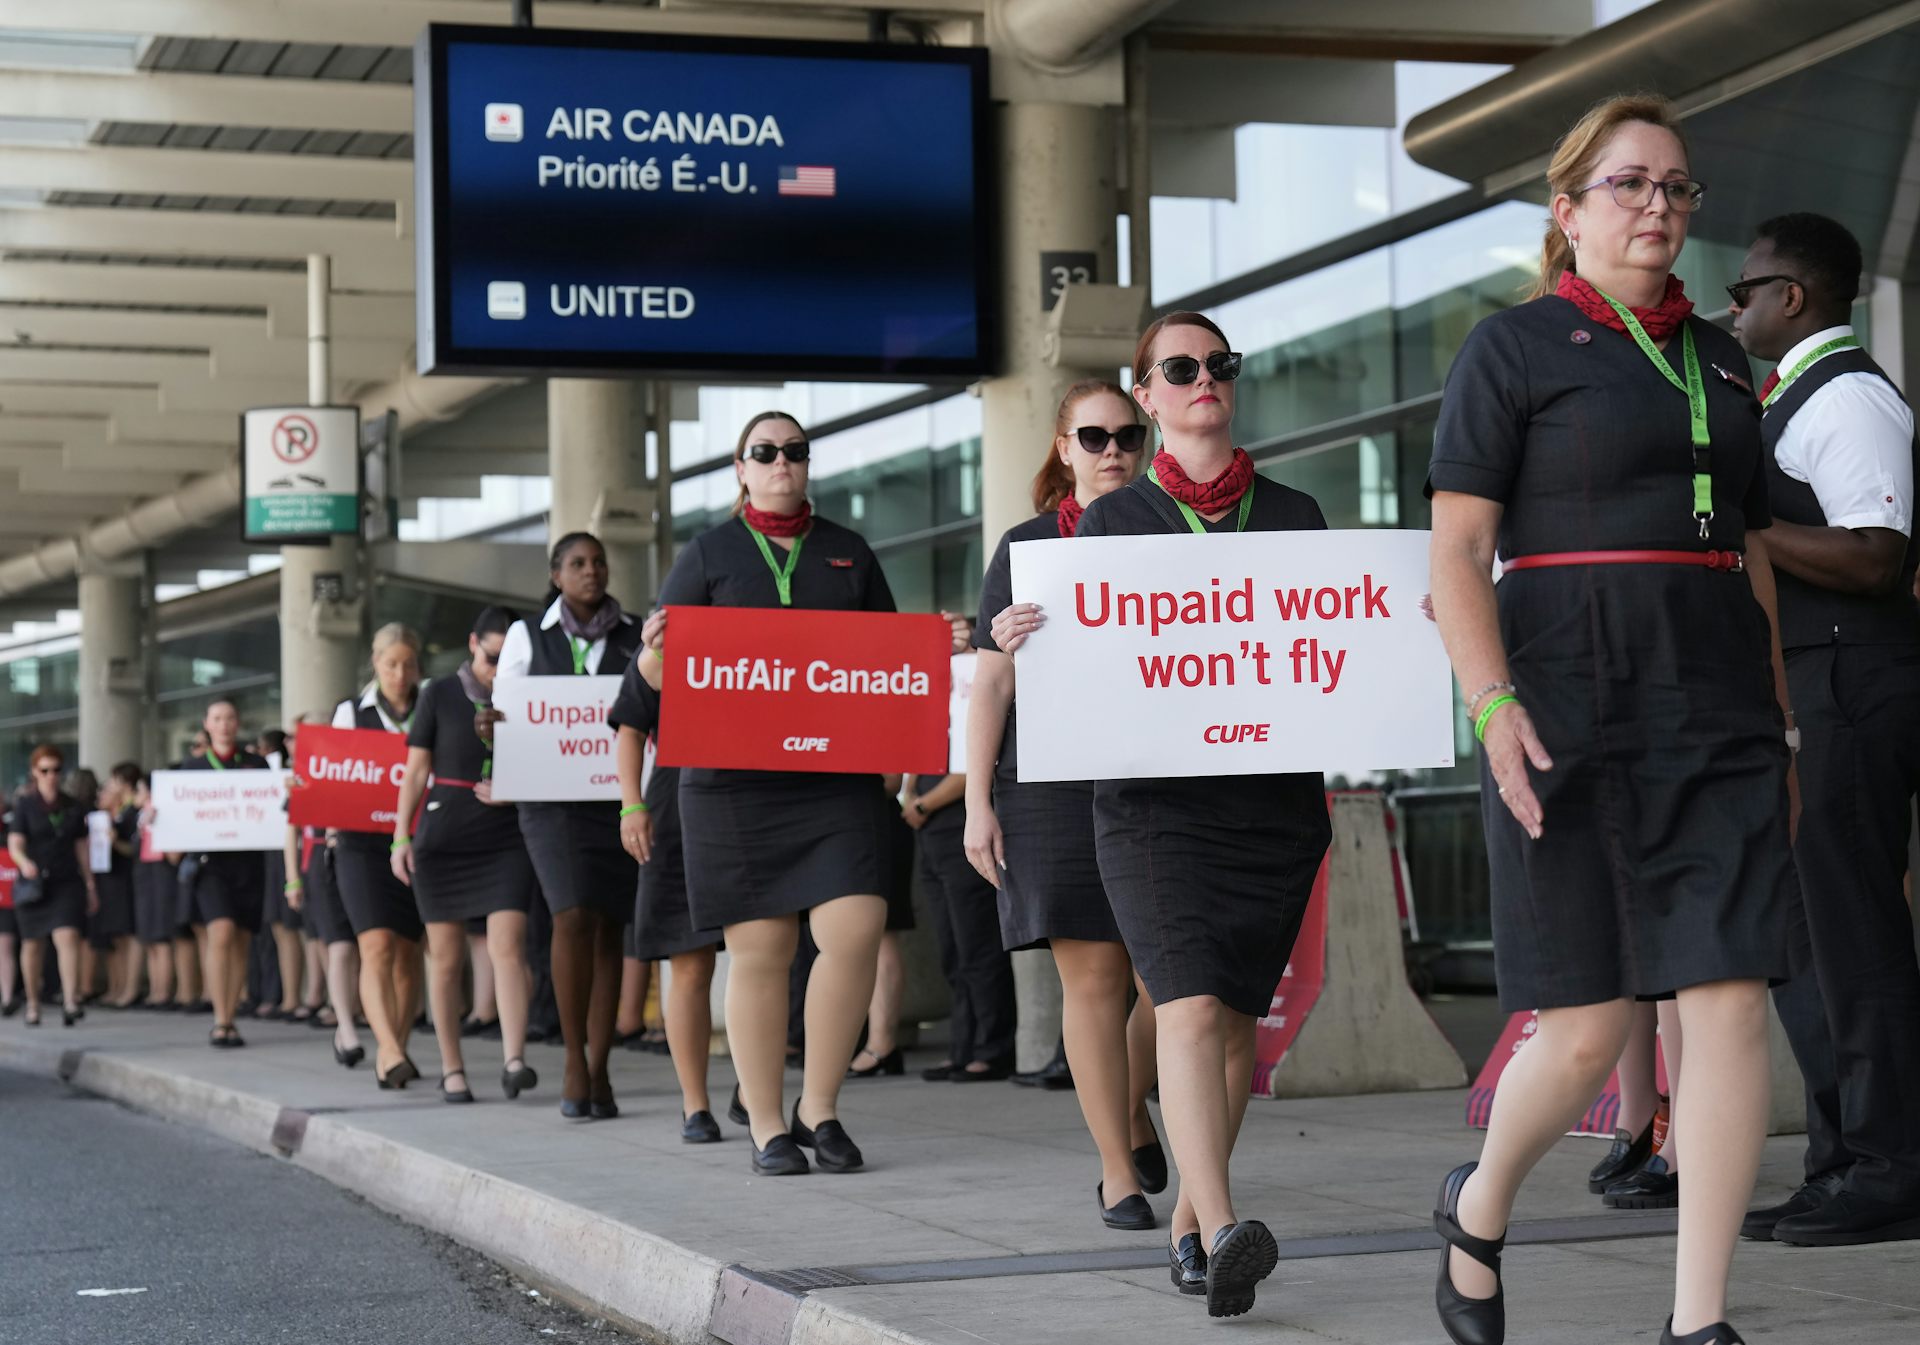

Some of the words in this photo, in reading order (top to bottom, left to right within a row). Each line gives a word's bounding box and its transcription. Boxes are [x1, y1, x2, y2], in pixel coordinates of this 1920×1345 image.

[545, 106, 613, 142] AIR
[622, 109, 785, 147] CANADA
[538, 155, 662, 191] Priorité
[671, 153, 758, 194] É.-U.
[550, 283, 696, 319] UNITED
[1795, 345, 1829, 371] Contract
[1074, 576, 1254, 637] Unpaid
[1274, 574, 1391, 621] work
[686, 656, 797, 692] UnfAir
[805, 659, 930, 696] Canada
[1137, 640, 1271, 689] won’t
[1288, 638, 1347, 694] fly
[558, 732, 617, 756] won’
[782, 736, 831, 752] CUPE
[1203, 723, 1271, 744] CUPE
[308, 755, 385, 785] UnfAir
[173, 785, 235, 803] Unpaid
[240, 785, 280, 799] work
[370, 810, 400, 823] CUP
